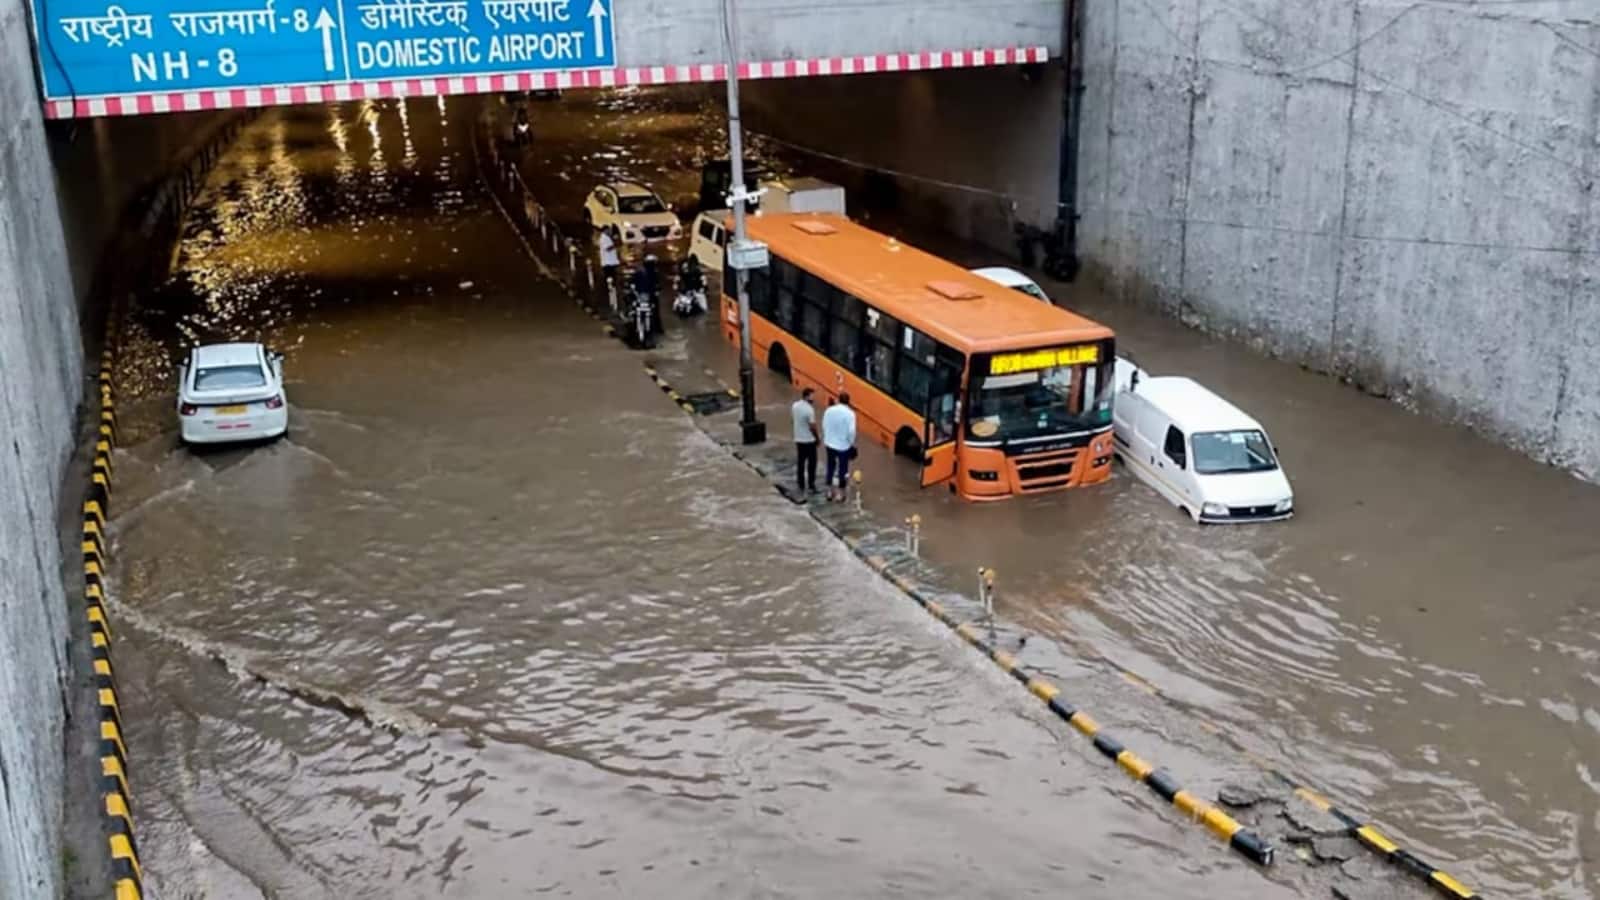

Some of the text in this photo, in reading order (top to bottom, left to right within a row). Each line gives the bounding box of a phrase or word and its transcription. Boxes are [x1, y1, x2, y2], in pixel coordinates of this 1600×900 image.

[59, 6, 153, 47] राष्ट्रीय
[357, 32, 585, 69] DOMESTIC AIRPORT
